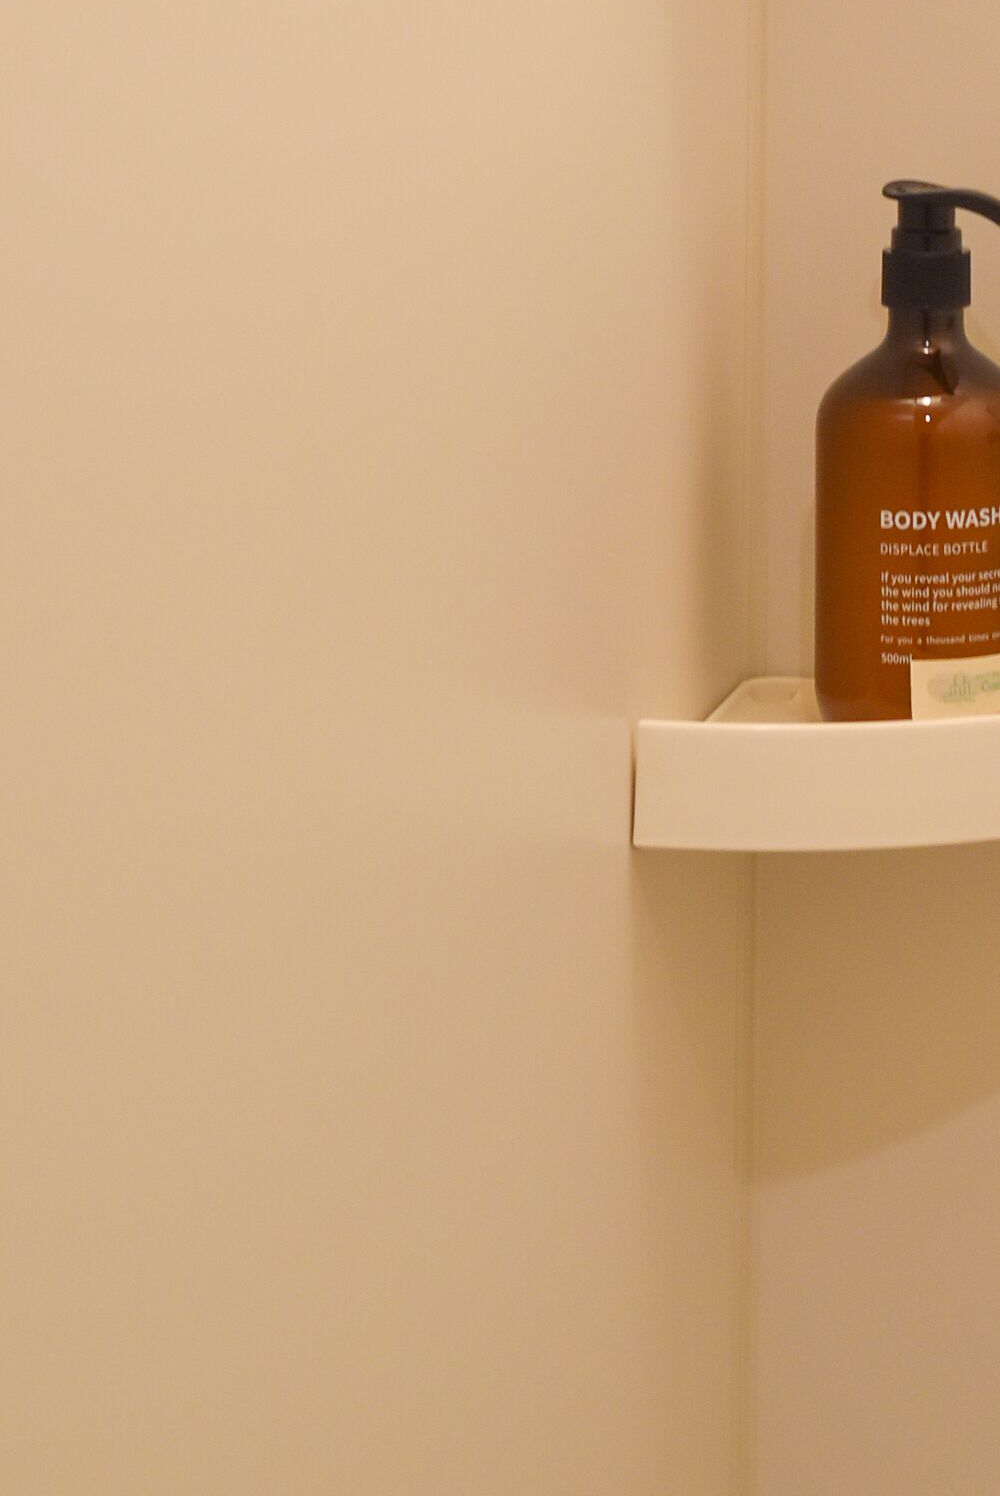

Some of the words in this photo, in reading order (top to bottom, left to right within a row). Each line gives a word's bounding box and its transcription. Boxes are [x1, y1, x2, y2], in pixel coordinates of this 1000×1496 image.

[880, 509, 940, 530] BODY
[880, 543, 939, 556] DISPLACE
[944, 540, 988, 555] BOTTLE
[881, 571, 888, 582] If
[891, 573, 911, 586] you
[915, 572, 949, 585] reveal
[952, 573, 975, 586] your
[881, 586, 899, 598] the
[902, 586, 929, 598] wind
[933, 589, 952, 602] you
[956, 583, 989, 596] should
[881, 600, 899, 612] the
[902, 600, 929, 612] wind
[933, 600, 948, 612] for
[952, 596, 997, 612] revealing
[881, 614, 899, 626] the
[902, 615, 930, 627] trees
[881, 634, 893, 644] For
[897, 635, 913, 646] you
[917, 637, 922, 645] a
[927, 633, 965, 645] thousand
[881, 652, 912, 664] 500ml
